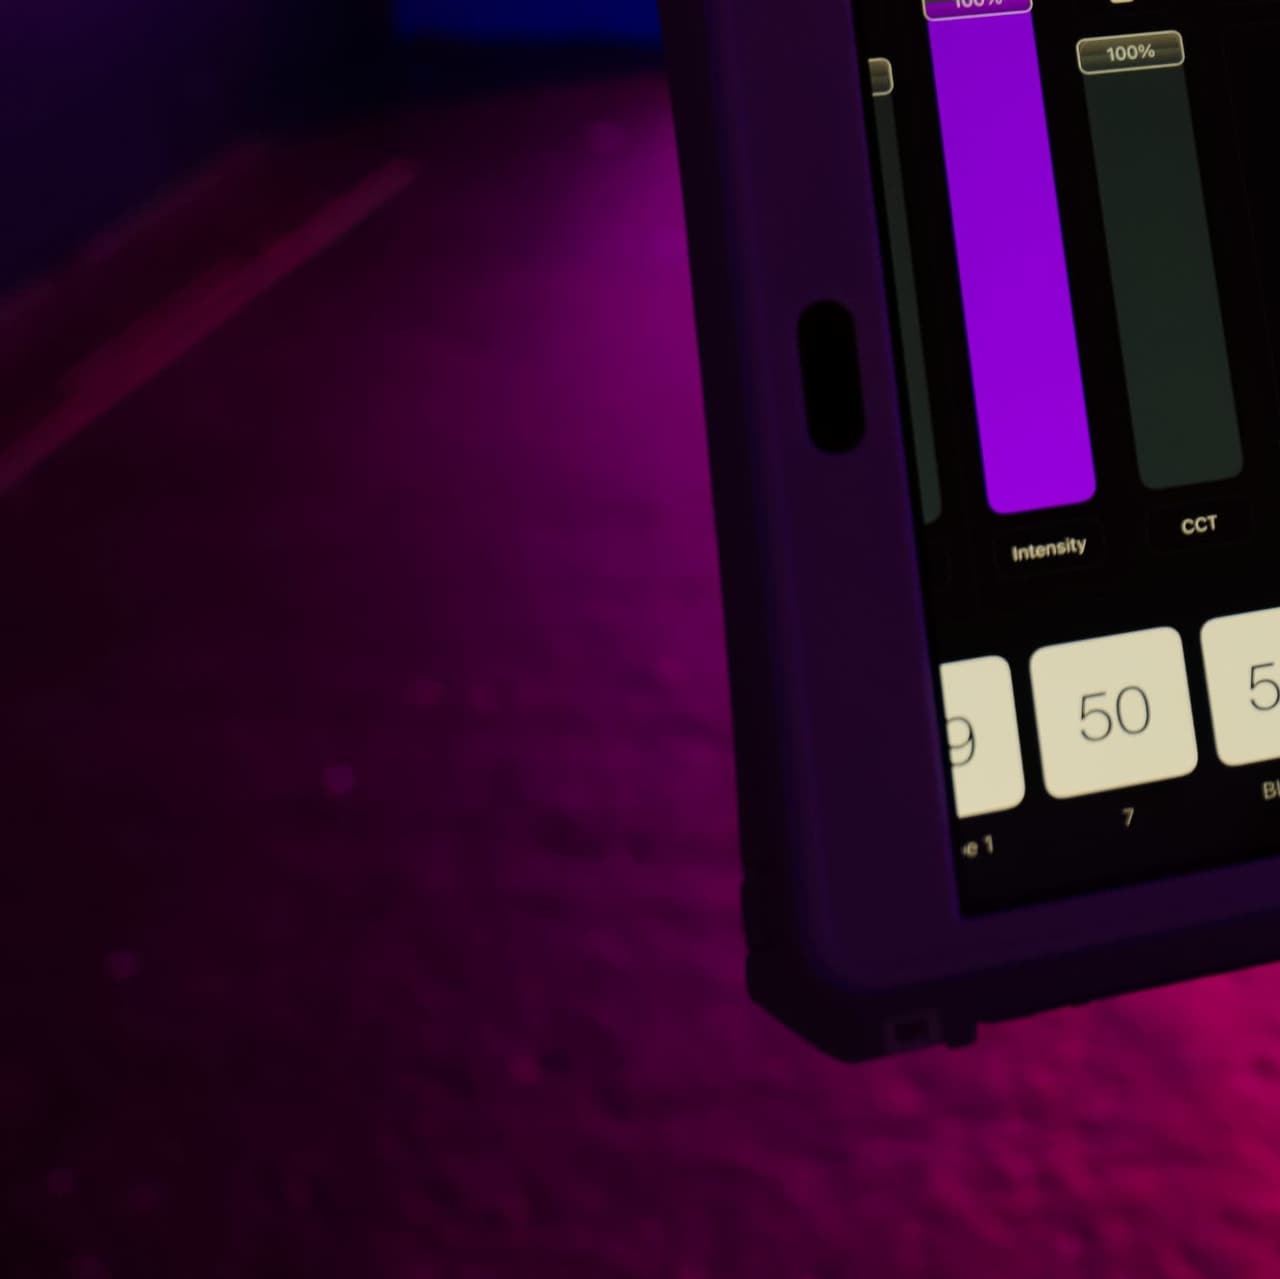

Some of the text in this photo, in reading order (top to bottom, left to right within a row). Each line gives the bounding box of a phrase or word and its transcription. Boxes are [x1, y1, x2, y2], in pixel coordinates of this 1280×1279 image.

[1106, 43, 1156, 63] 100%
[1181, 514, 1219, 536] CCT
[1011, 536, 1087, 562] Intensity
[1080, 685, 1151, 742] 50
[1122, 807, 1135, 827] 7
